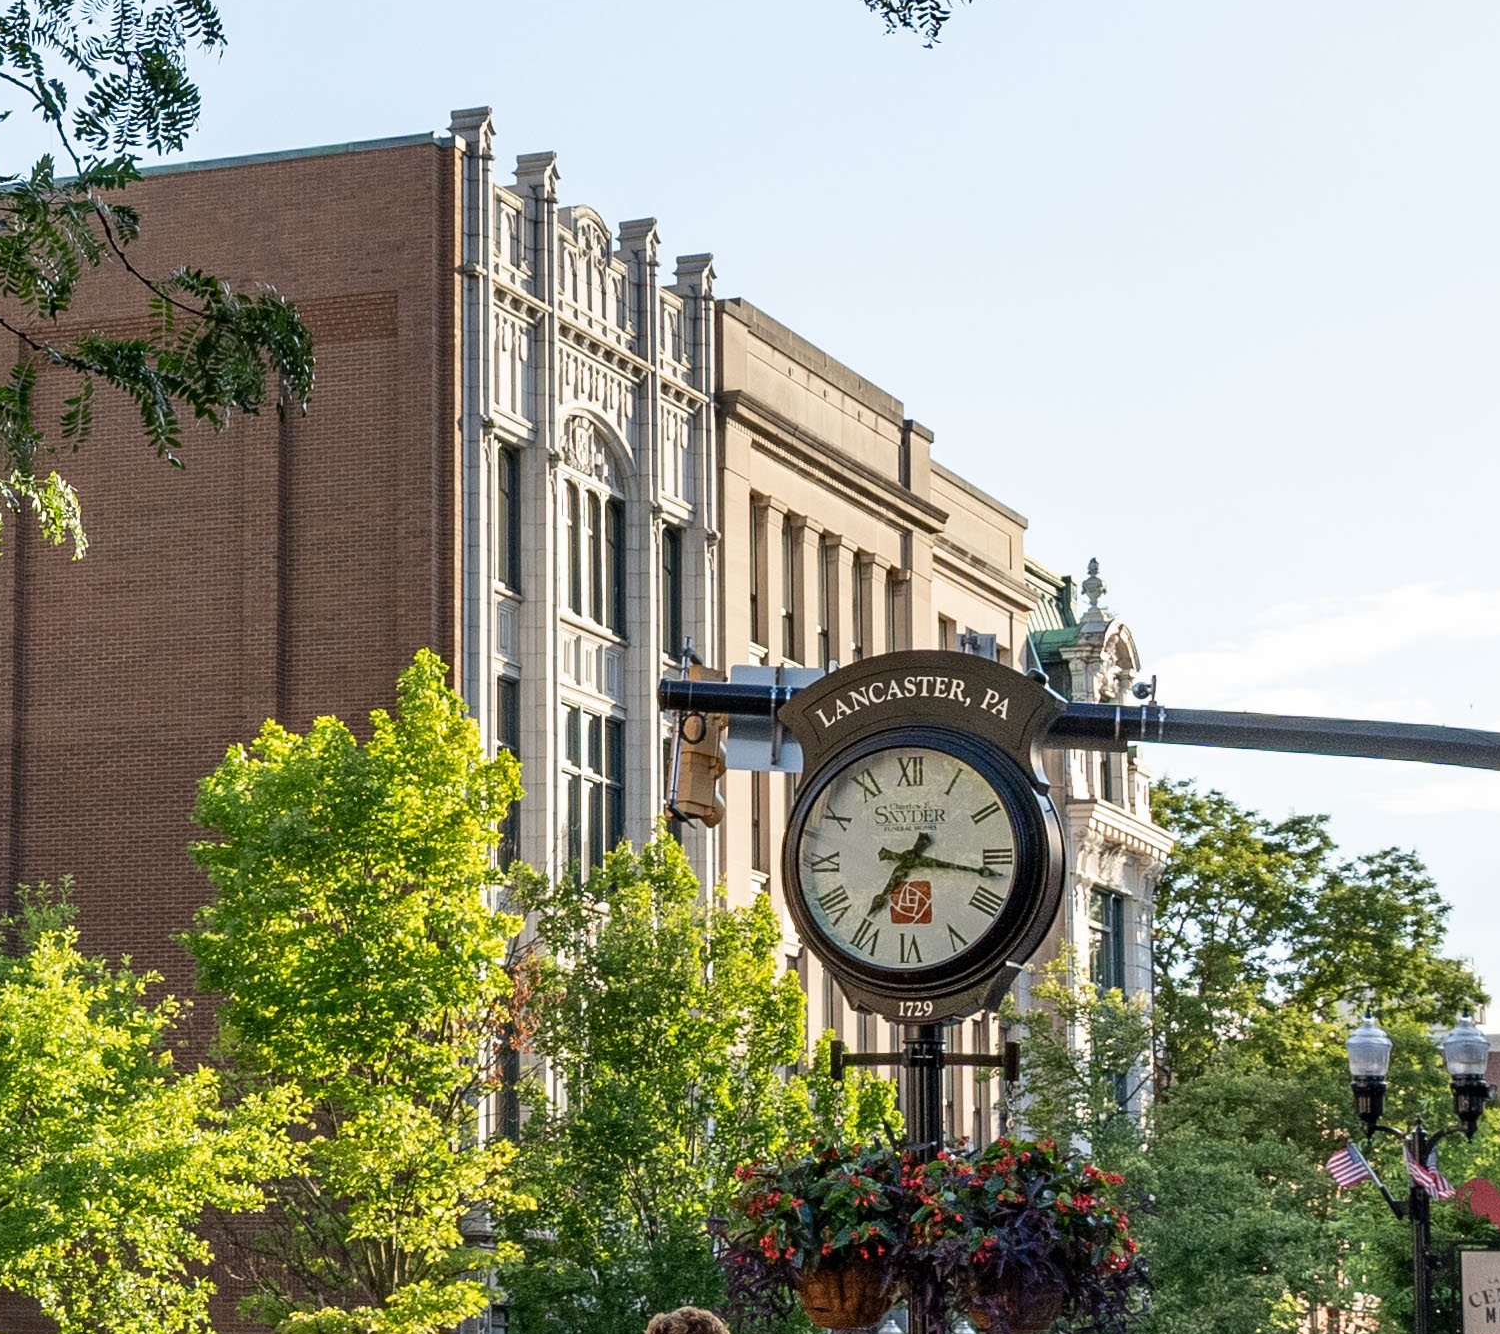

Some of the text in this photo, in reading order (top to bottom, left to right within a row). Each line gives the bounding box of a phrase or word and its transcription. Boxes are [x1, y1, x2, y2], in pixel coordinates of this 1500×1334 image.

[815, 676, 1010, 728] LANCASTER, PA
[875, 806, 945, 824] SNYDER
[899, 1001, 933, 1017] 1729
